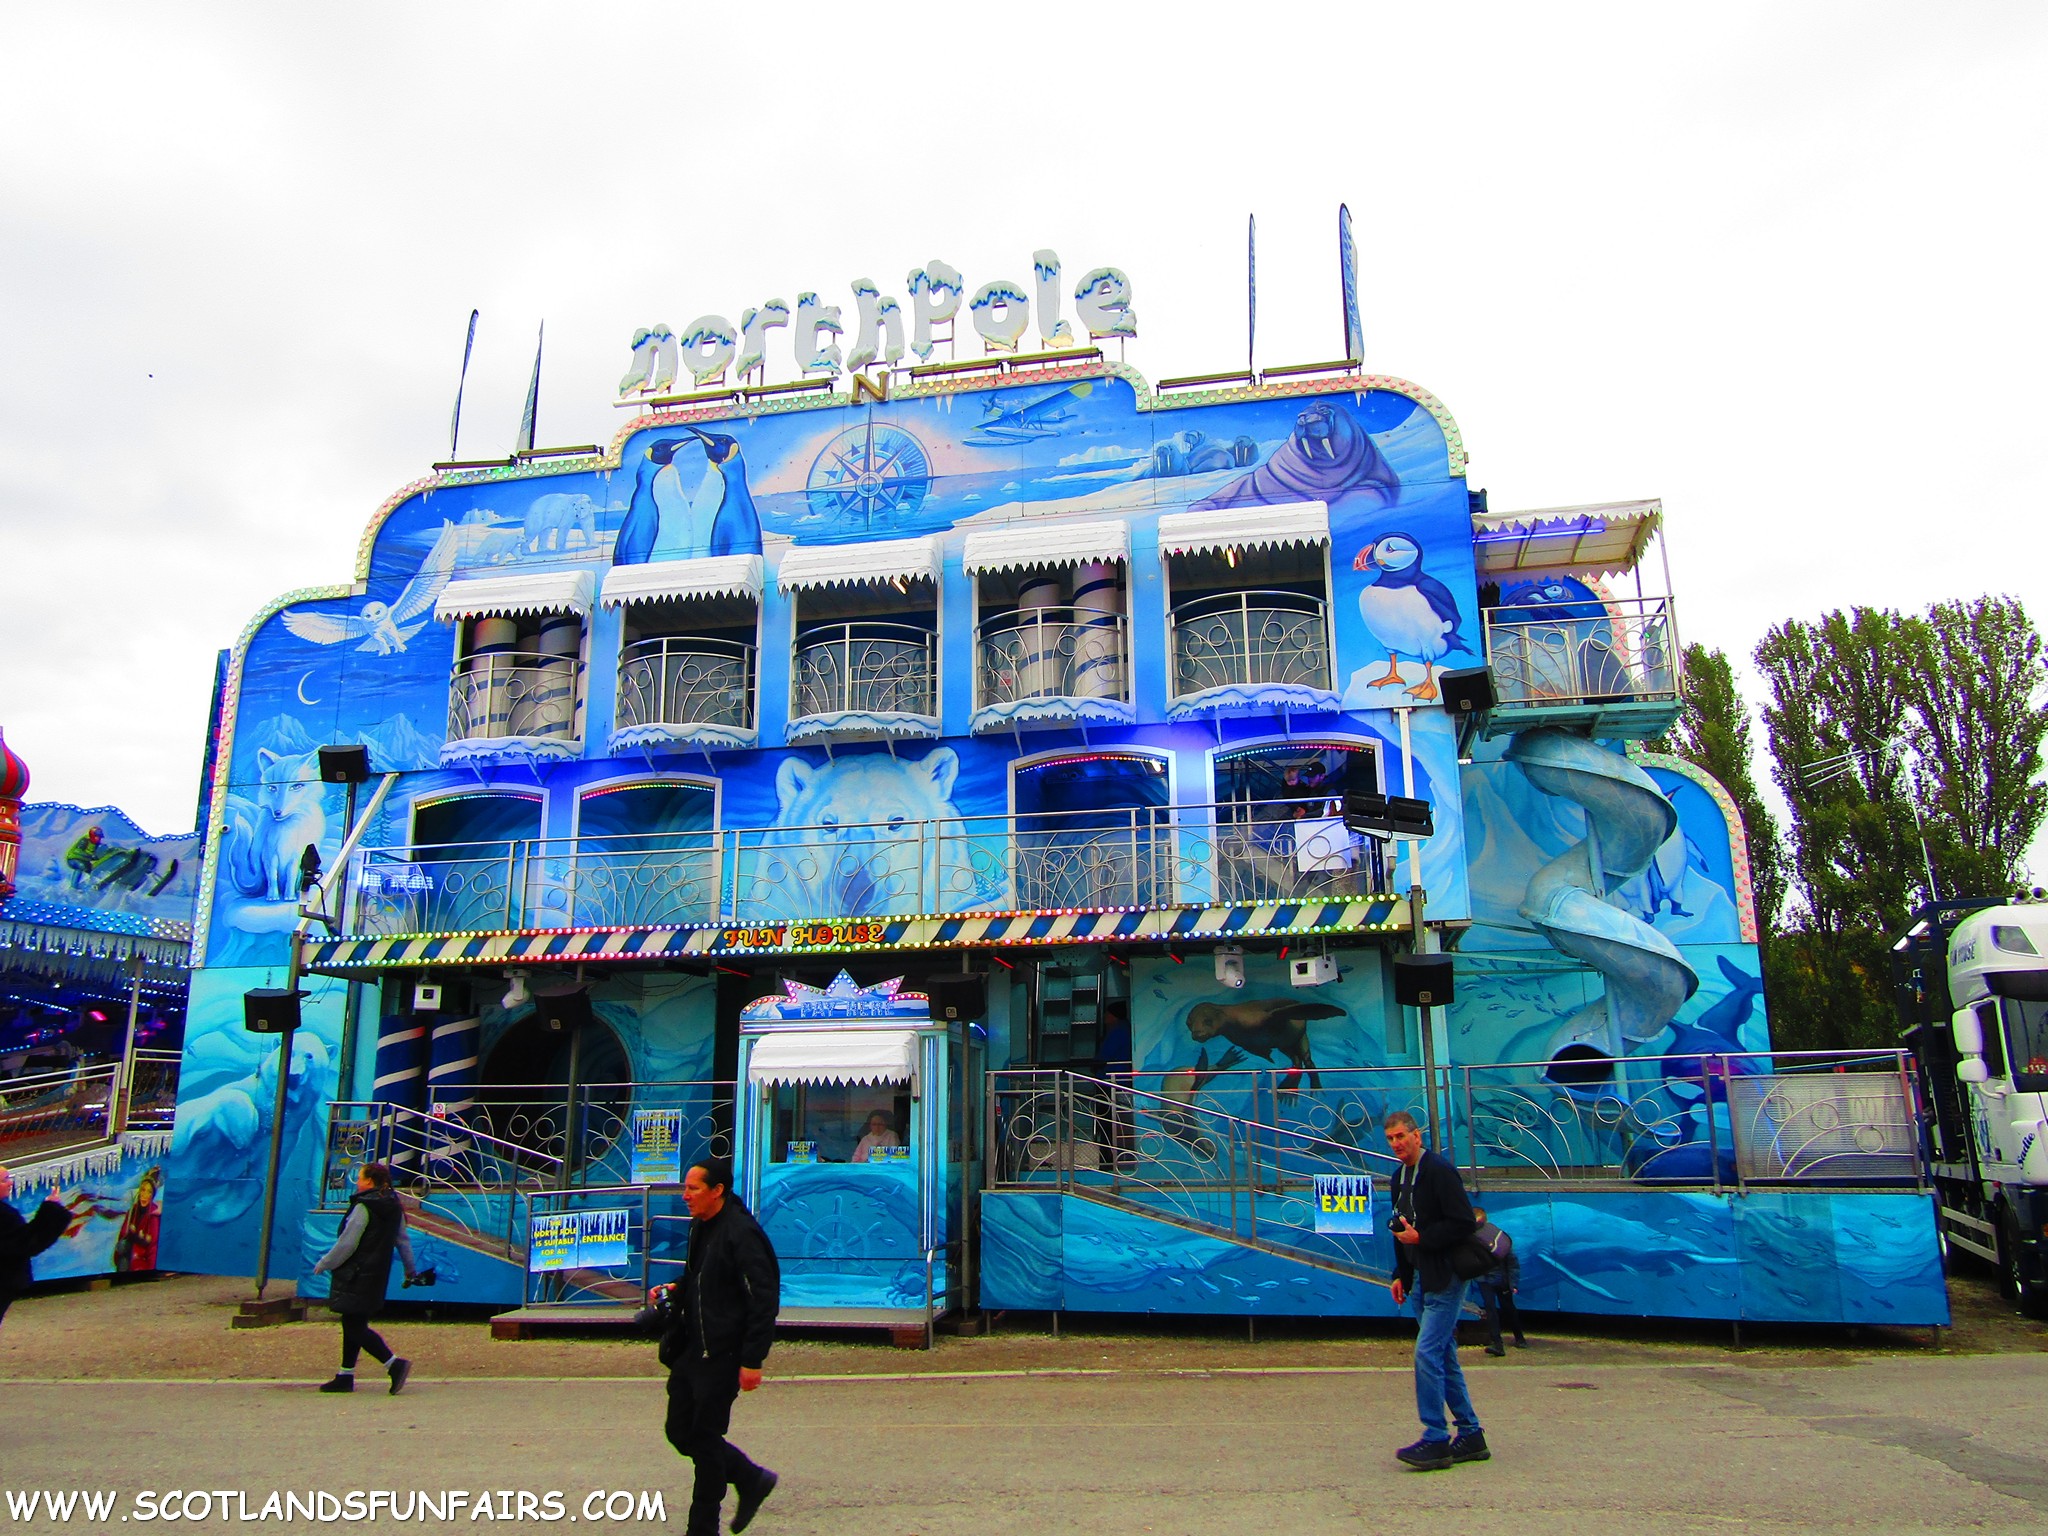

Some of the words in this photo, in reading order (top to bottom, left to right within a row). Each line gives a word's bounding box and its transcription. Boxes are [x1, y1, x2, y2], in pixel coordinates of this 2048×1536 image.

[848, 370, 890, 404] N
[723, 926, 787, 947] FUN
[791, 924, 886, 945] HOUSE
[801, 1000, 835, 1017] PAY
[846, 1000, 895, 1016] HERE
[1321, 1195, 1367, 1213] EXIT
[534, 1229, 559, 1238] NORTH
[559, 1228, 577, 1236] POLE
[582, 1233, 626, 1244] ENTRANCE
[544, 1238, 575, 1246] SUITABLE
